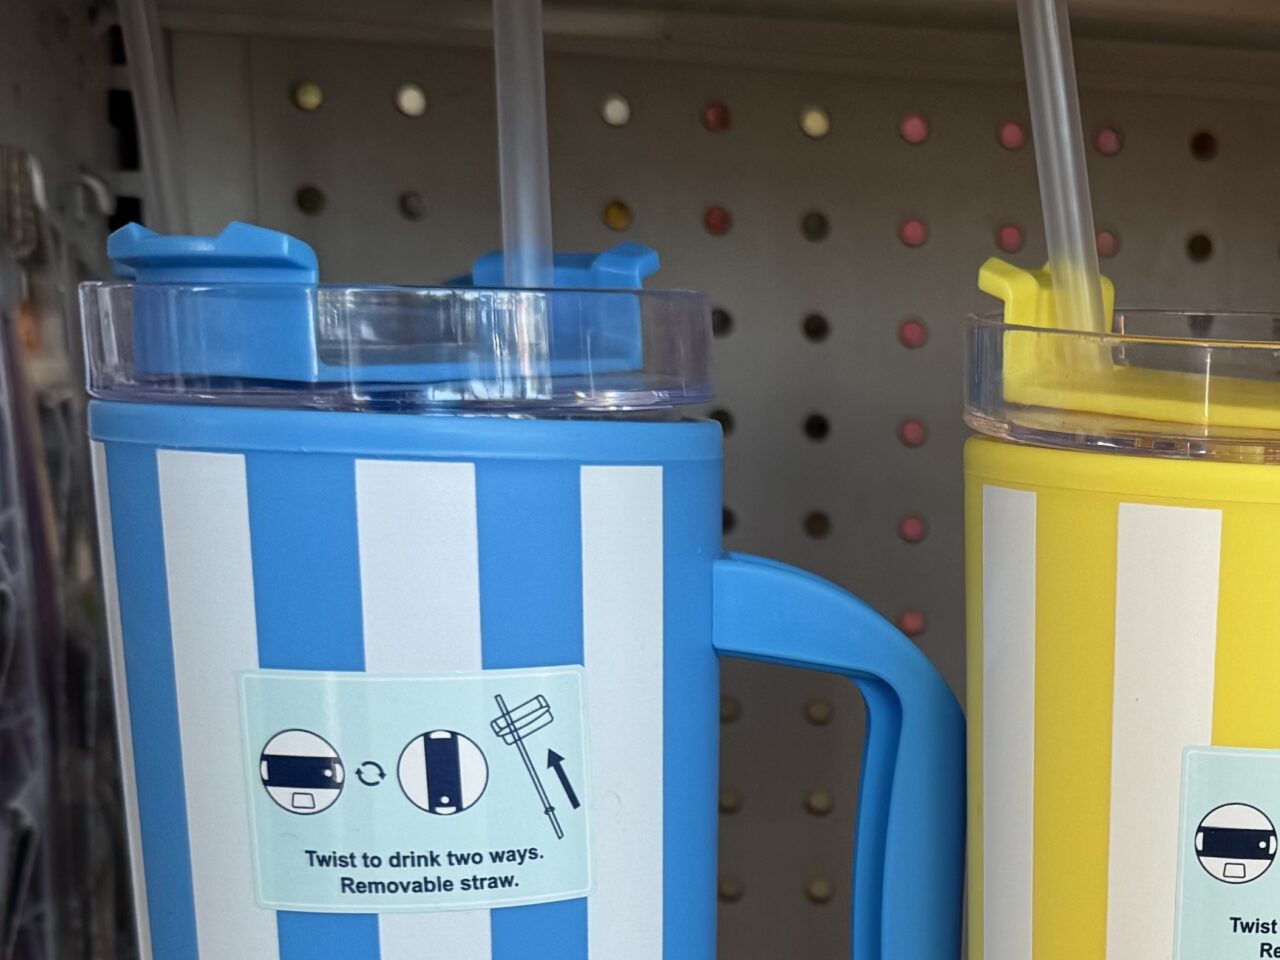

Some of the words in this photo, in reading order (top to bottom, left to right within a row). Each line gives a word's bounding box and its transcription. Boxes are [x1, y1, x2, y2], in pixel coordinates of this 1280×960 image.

[305, 850, 357, 869] Twist
[361, 852, 383, 869] to
[388, 849, 442, 868] drink
[446, 850, 484, 867] two
[489, 846, 545, 866] ways.
[340, 876, 454, 894] Removable
[460, 873, 520, 891] straw.
[1230, 917, 1278, 934] Twist
